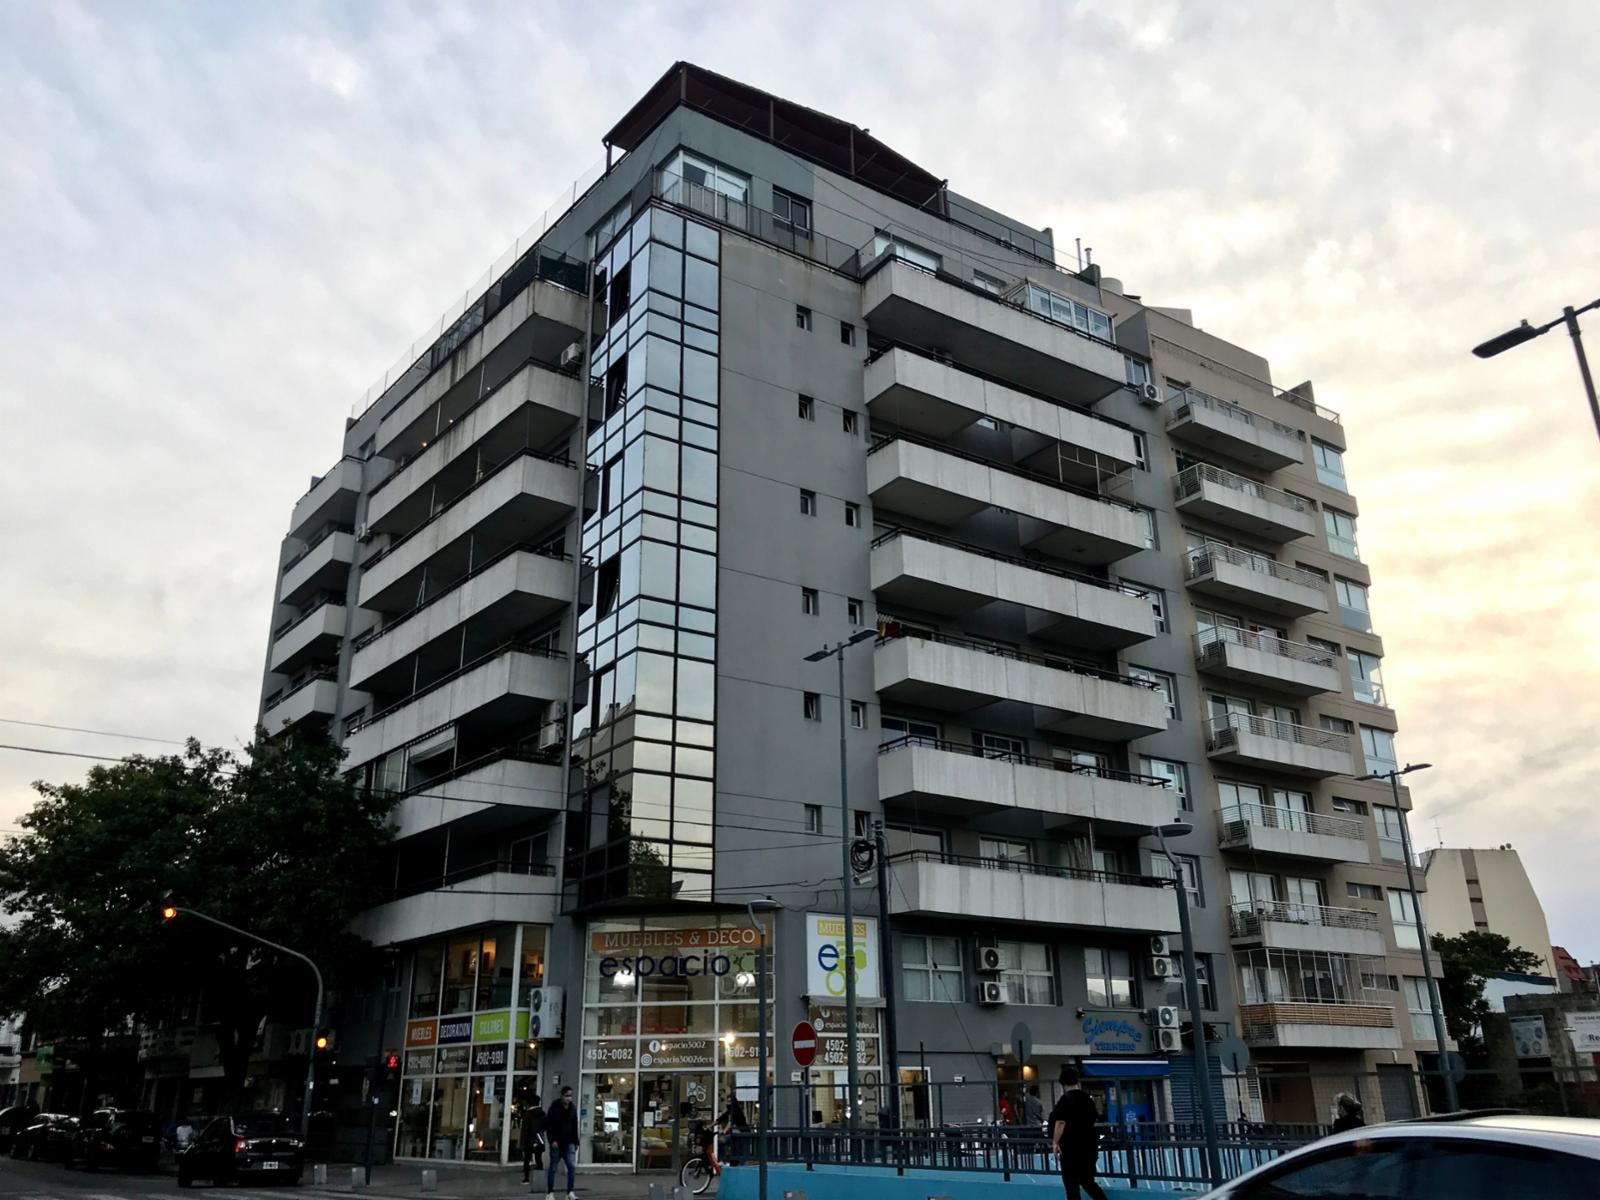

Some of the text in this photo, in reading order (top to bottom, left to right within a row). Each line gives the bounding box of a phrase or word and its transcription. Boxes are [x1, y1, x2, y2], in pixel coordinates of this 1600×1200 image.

[604, 929, 756, 948] MUEBLES & DECO
[600, 949, 731, 995] espacio
[411, 1026, 432, 1040] MUEBLES
[825, 1040, 866, 1052] 4502-90
[586, 1048, 633, 1061] 4502-0082
[824, 1052, 867, 1064] 4502-82
